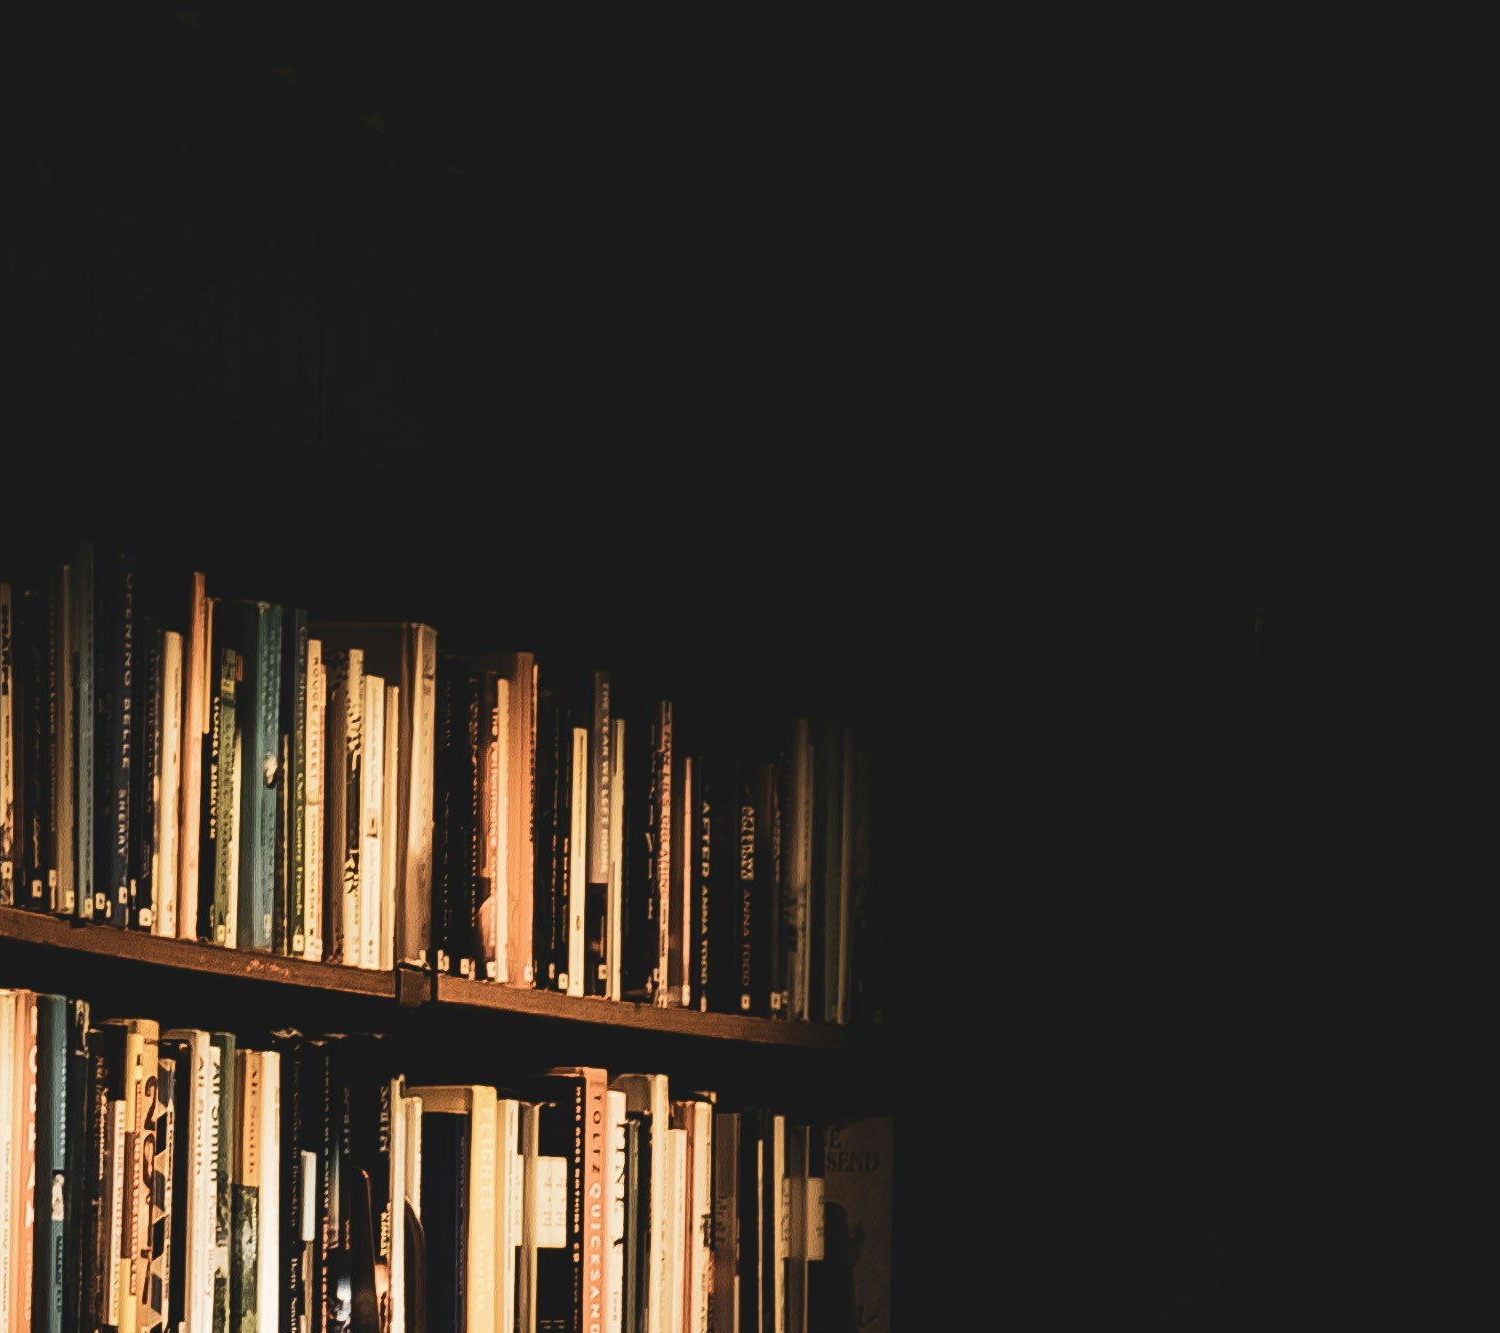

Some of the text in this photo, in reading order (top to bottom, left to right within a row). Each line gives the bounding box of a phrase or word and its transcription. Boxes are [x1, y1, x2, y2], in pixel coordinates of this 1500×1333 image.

[121, 697, 131, 769] BELLE
[700, 801, 710, 877] AFTER
[700, 939, 708, 985] TODD
[742, 888, 750, 985] ANNA TODD
[826, 1151, 880, 1173] SEND
